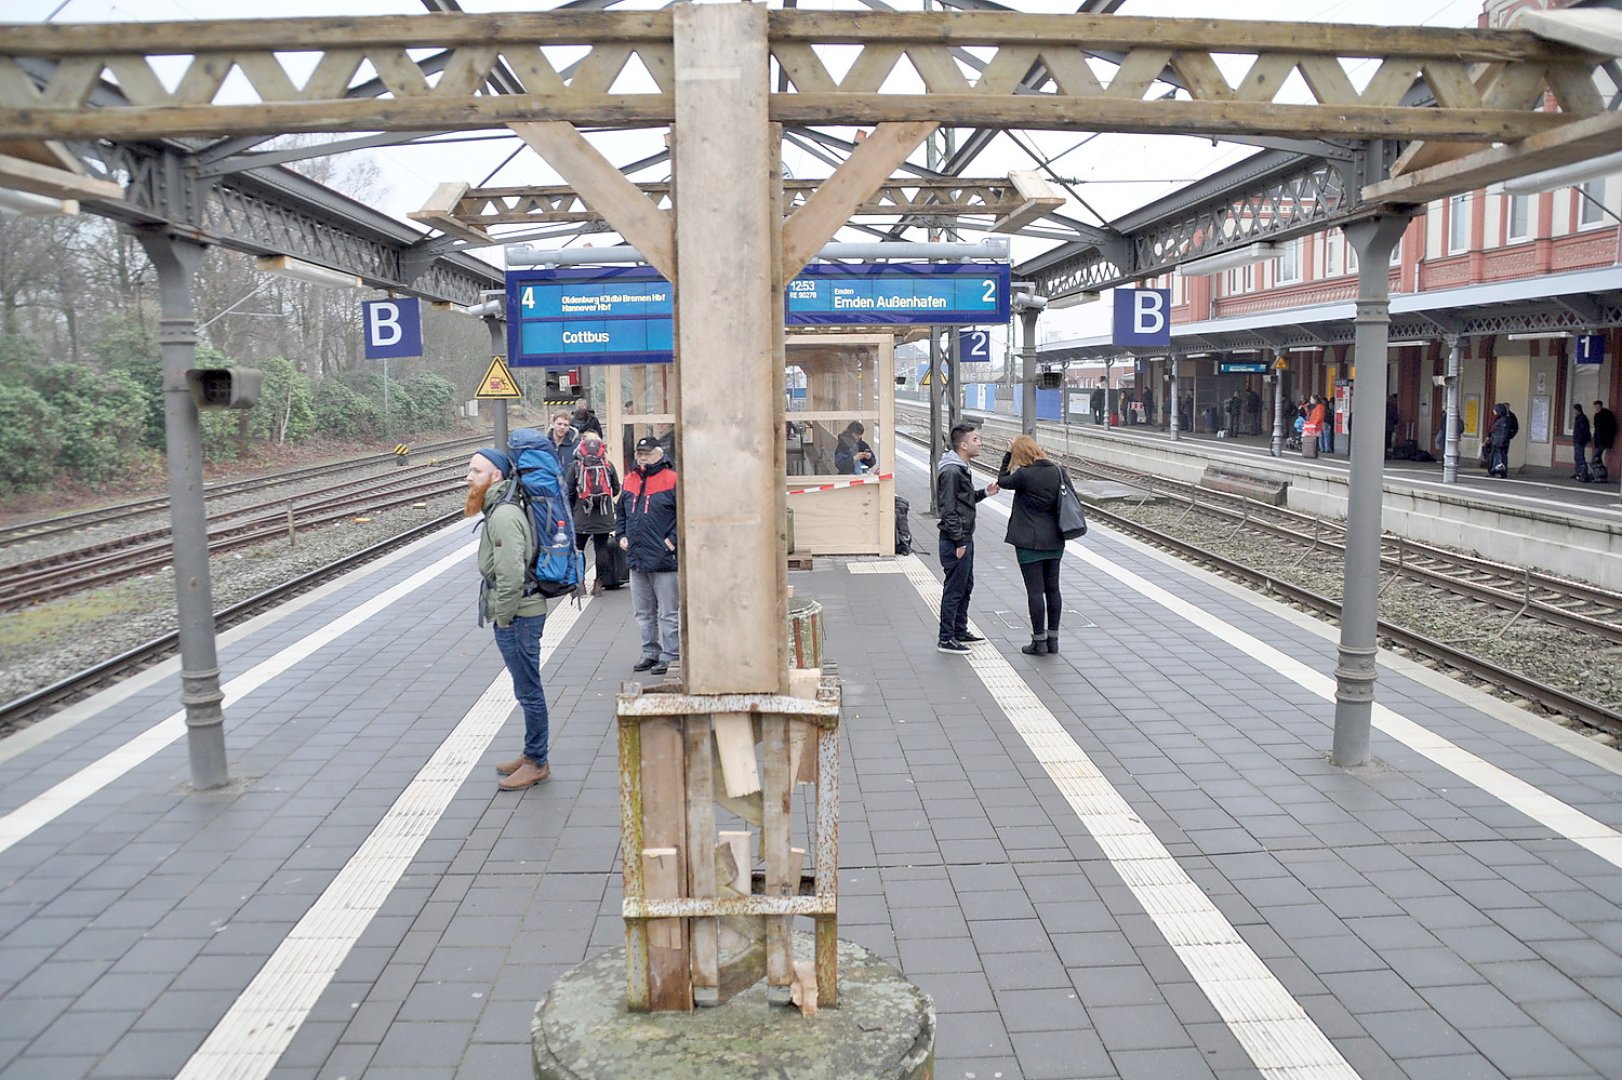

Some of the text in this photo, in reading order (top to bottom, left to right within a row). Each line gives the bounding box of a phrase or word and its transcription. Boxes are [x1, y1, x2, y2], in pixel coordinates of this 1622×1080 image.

[521, 286, 535, 309] 4
[562, 296, 600, 306] Oldenburg
[622, 294, 651, 302] Bremen
[652, 293, 666, 301] Hbf
[834, 295, 947, 308] Emden Außenhafen
[982, 279, 996, 302] 2
[562, 303, 612, 312] Hannover Hbf
[1133, 290, 1165, 334] B
[369, 301, 403, 347] B
[562, 331, 609, 344] Cottbus
[970, 331, 987, 356] 2
[1580, 335, 1590, 358] 1
[1135, 360, 1141, 371] 1
